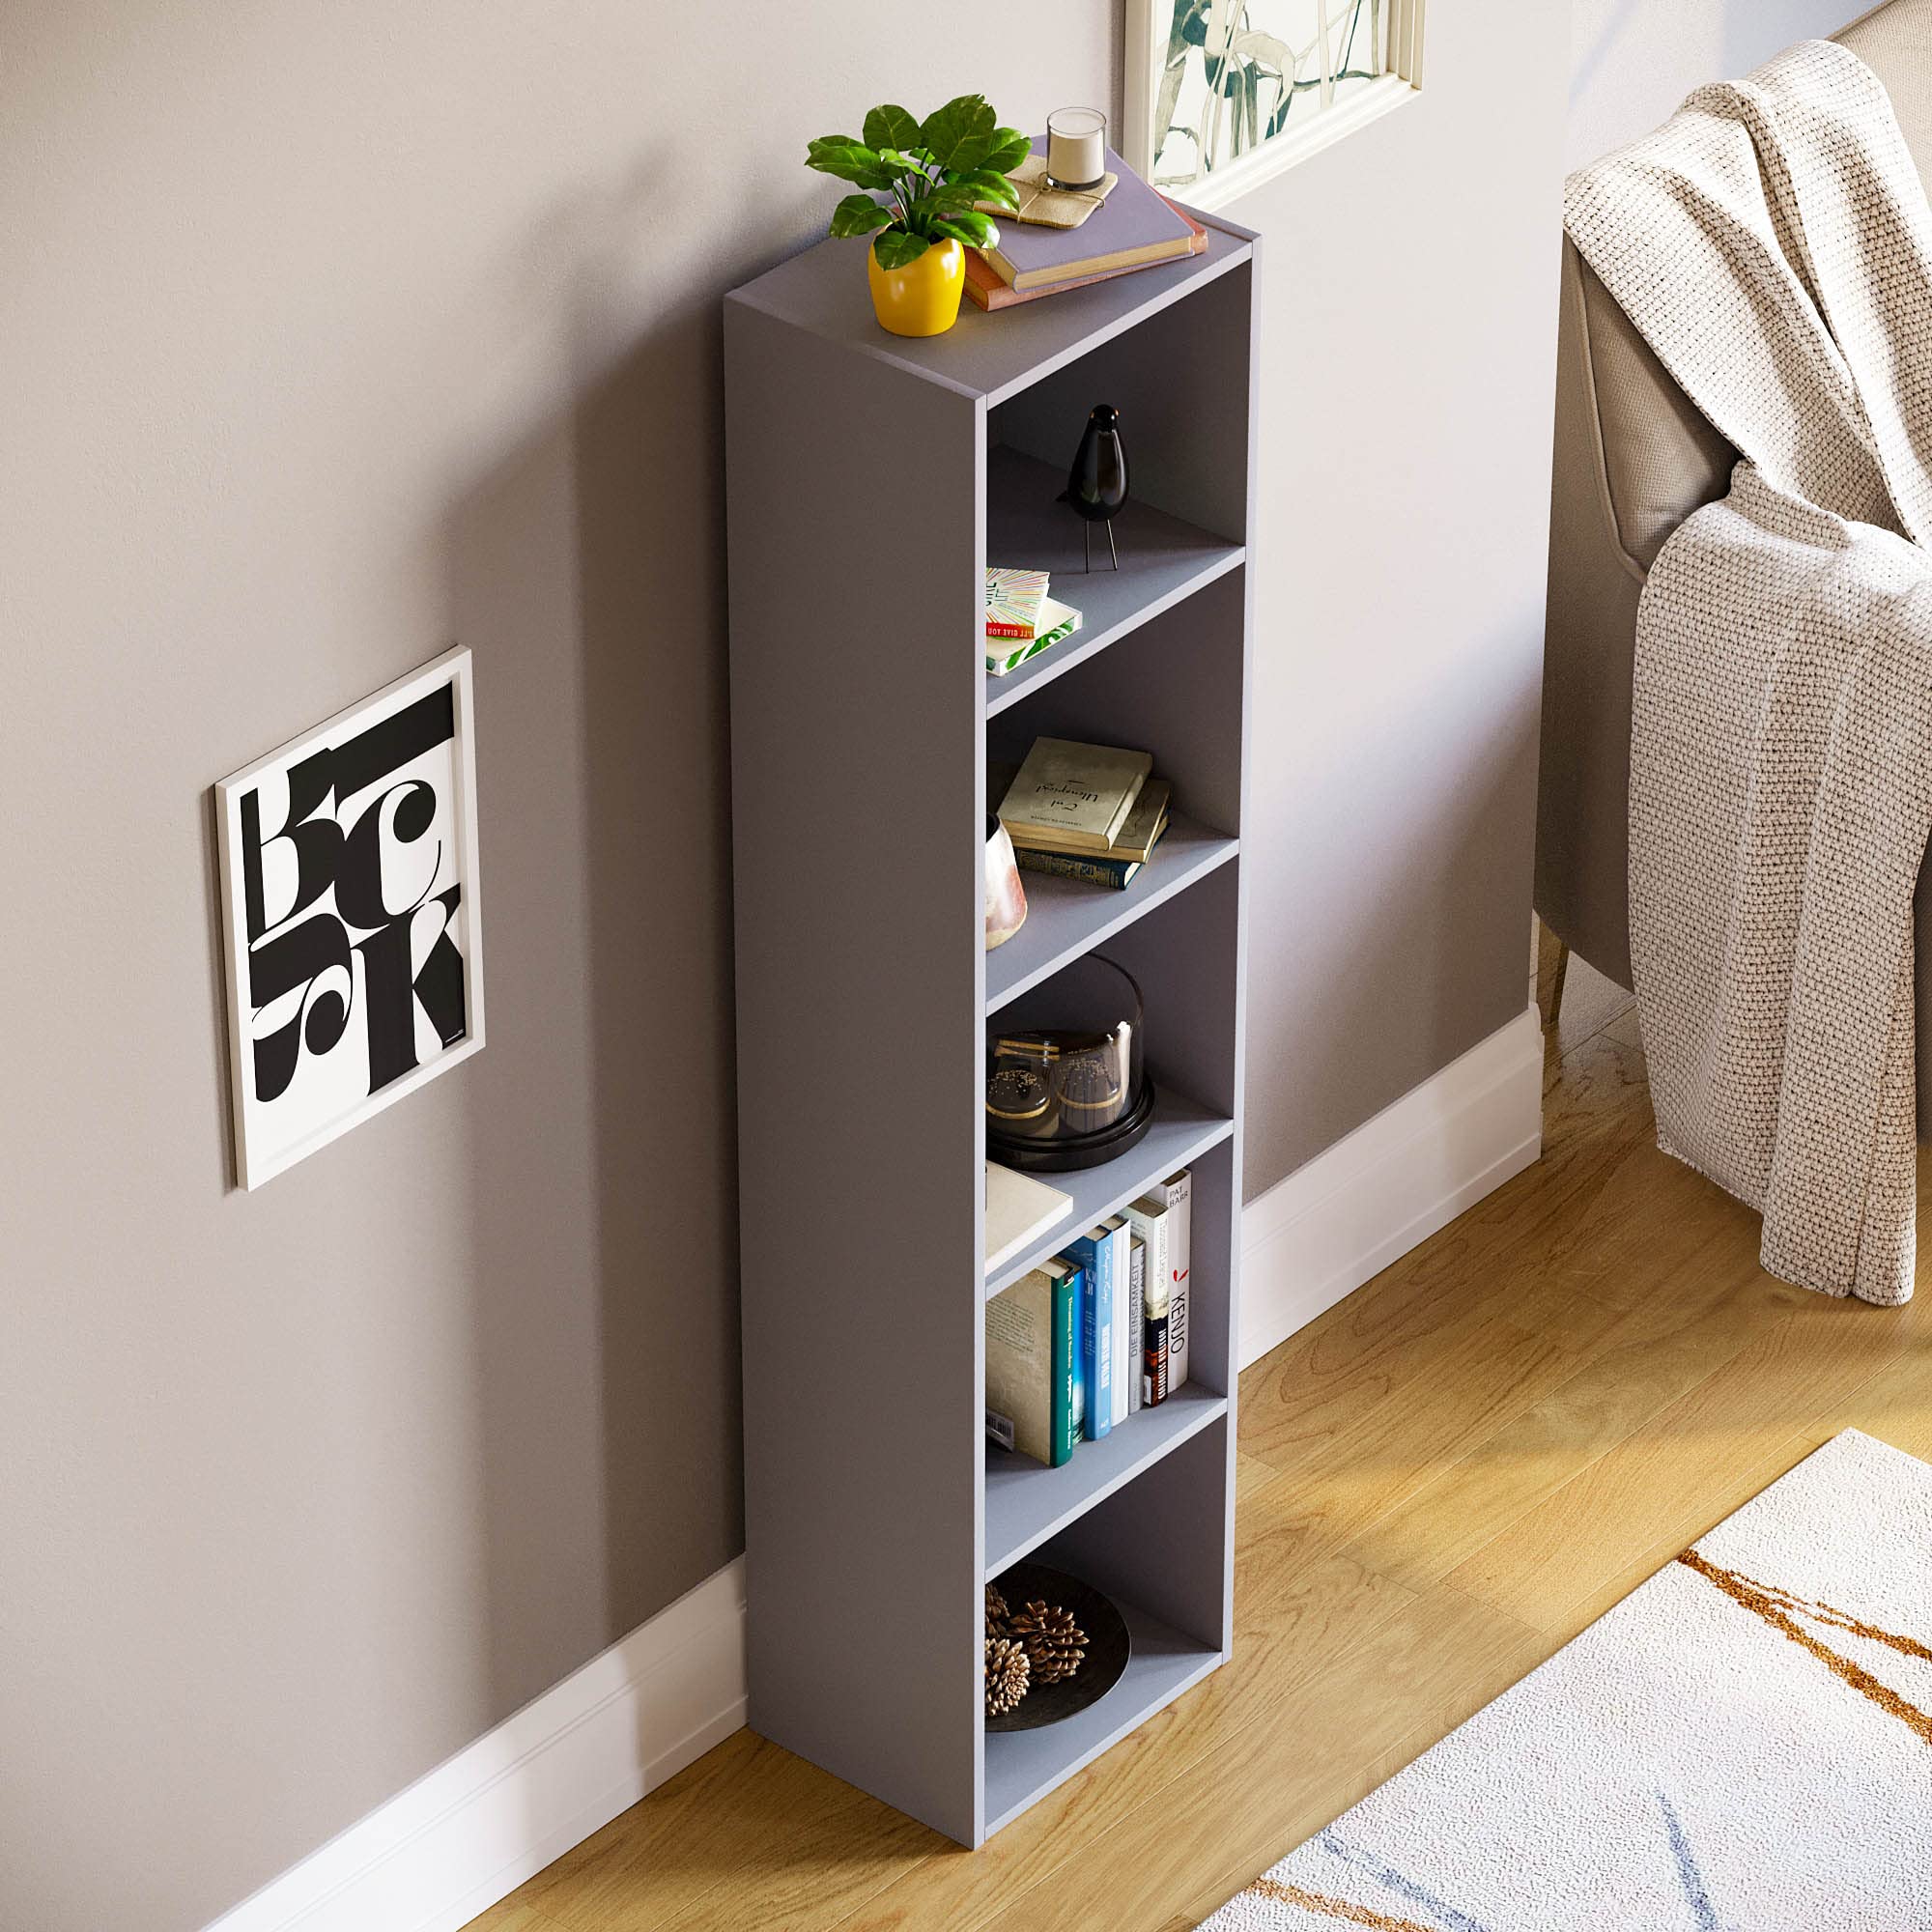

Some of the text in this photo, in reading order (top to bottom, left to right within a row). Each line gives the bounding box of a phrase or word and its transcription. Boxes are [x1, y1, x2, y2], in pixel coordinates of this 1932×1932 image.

[1169, 1185, 1182, 1199] PAT
[1169, 1190, 1189, 1208] BARR
[1130, 1264, 1139, 1335] EINSAMKEIT
[1170, 1292, 1186, 1354] KENJO
